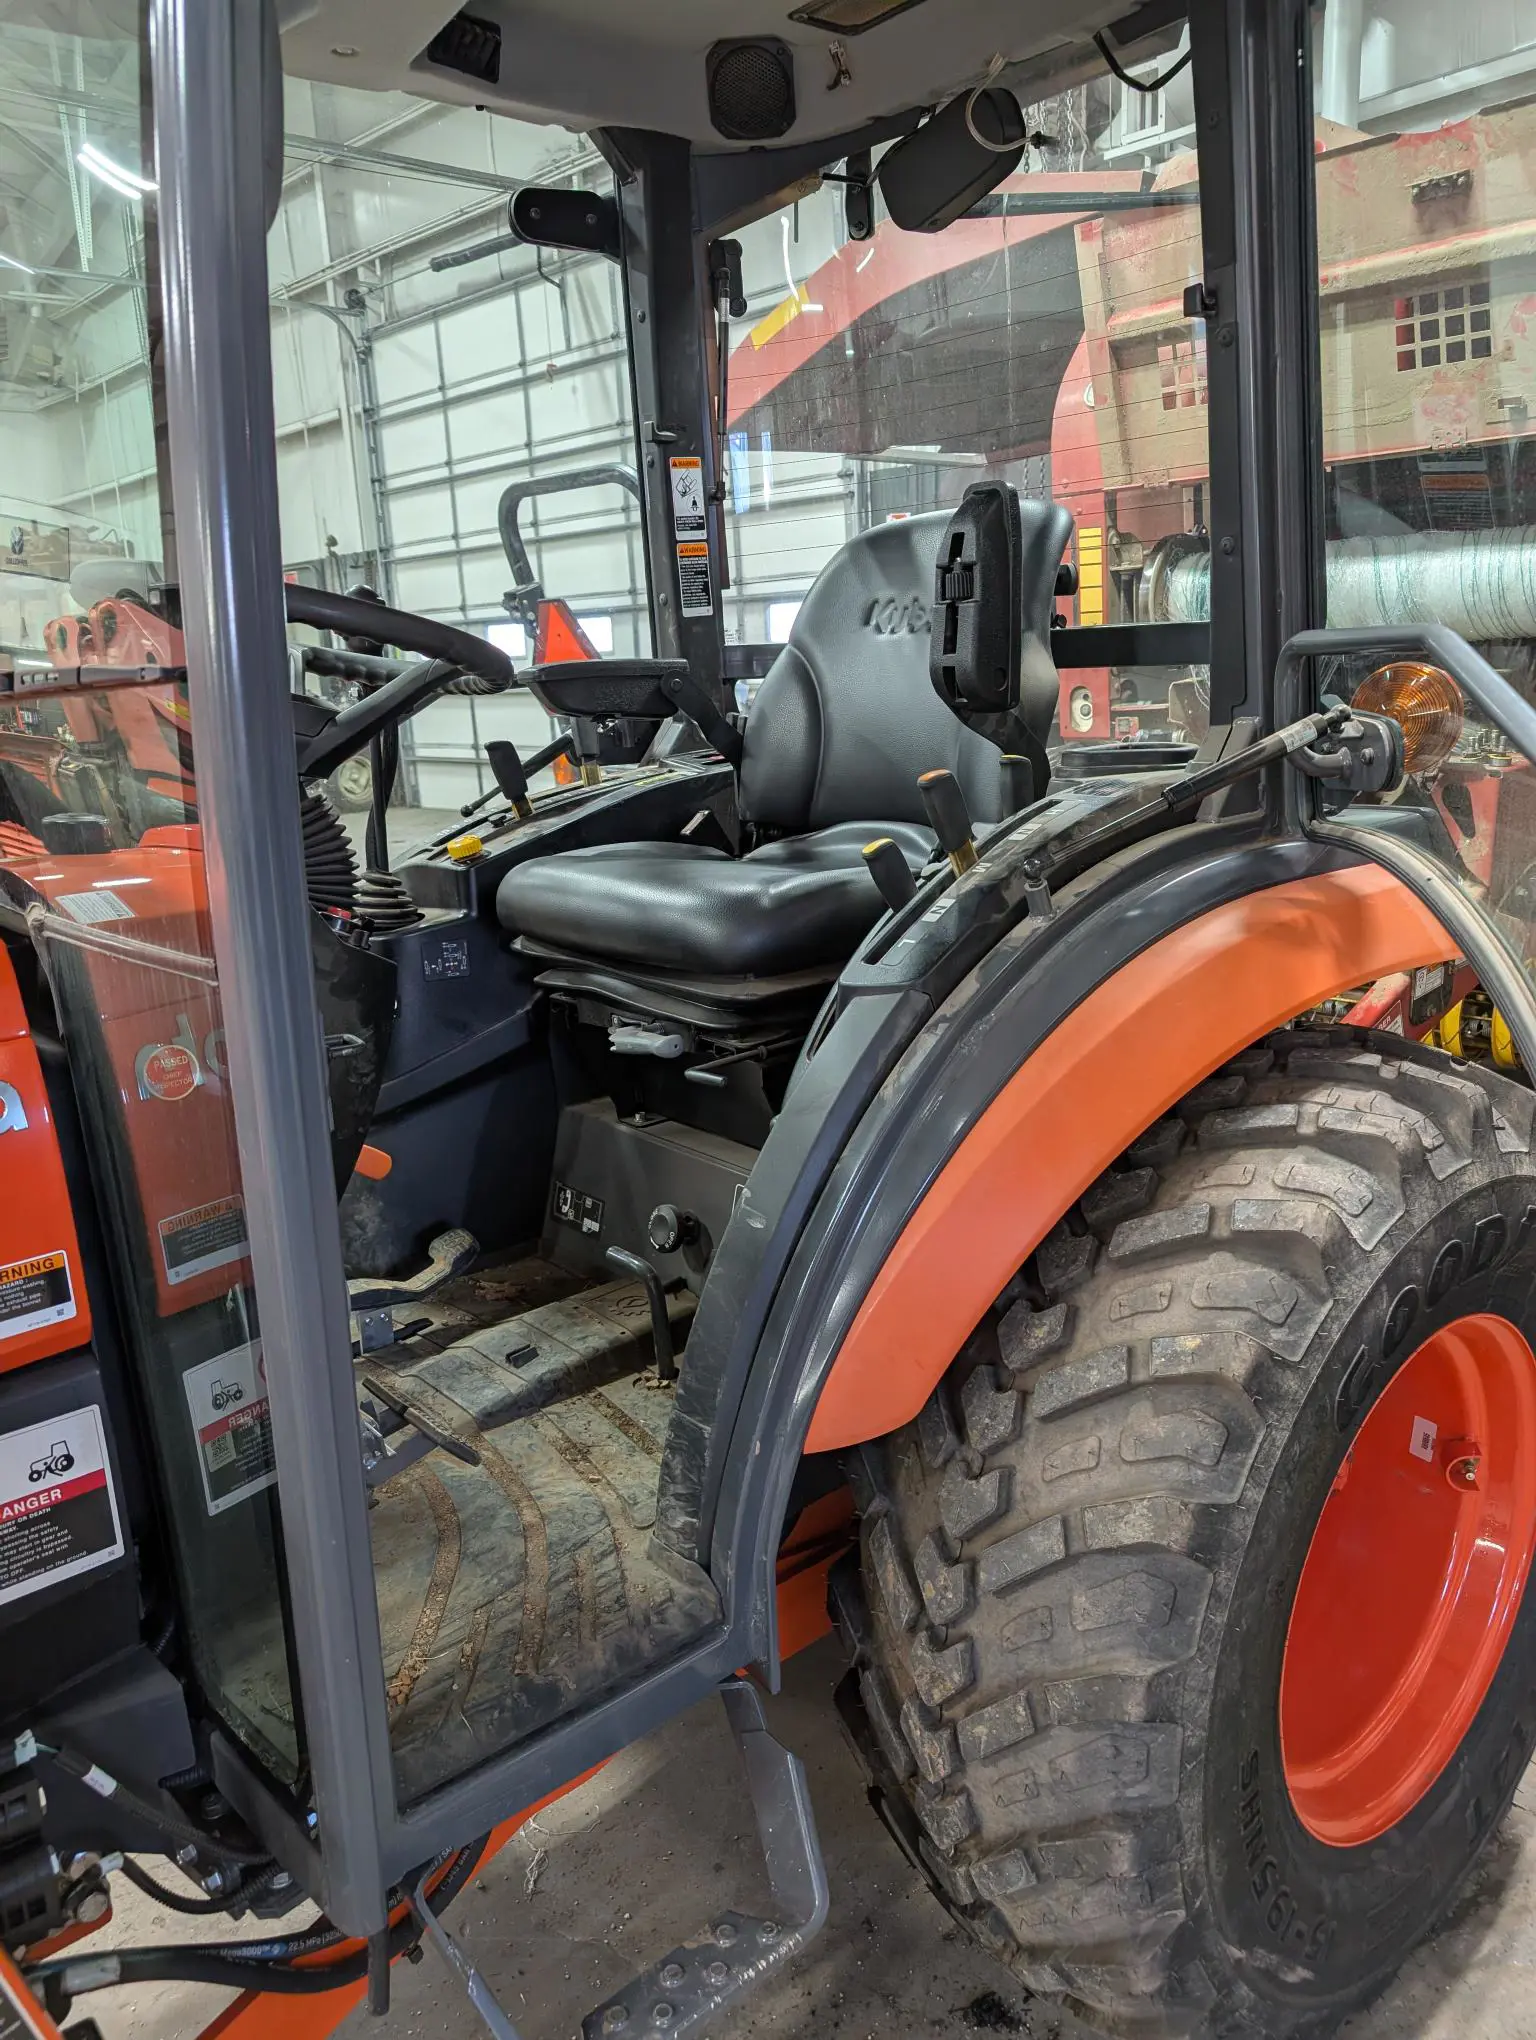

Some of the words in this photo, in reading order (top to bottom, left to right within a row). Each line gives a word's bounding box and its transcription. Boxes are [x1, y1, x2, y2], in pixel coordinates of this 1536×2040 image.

[153, 1055, 189, 1073] PASSED
[18, 1515, 28, 1523] OR
[29, 1507, 51, 1519] DEATH
[29, 1533, 39, 1541] the
[40, 1525, 59, 1537] safety
[30, 1521, 51, 1533] across
[4, 1549, 17, 1558] may
[19, 1542, 33, 1552] start
[42, 1534, 55, 1544] gear
[57, 1528, 68, 1537] and
[41, 1548, 55, 1558] seat
[56, 1543, 69, 1552] with
[10, 1549, 35, 1562] circuitry
[19, 1567, 45, 1581] standing
[55, 1558, 66, 1567] the
